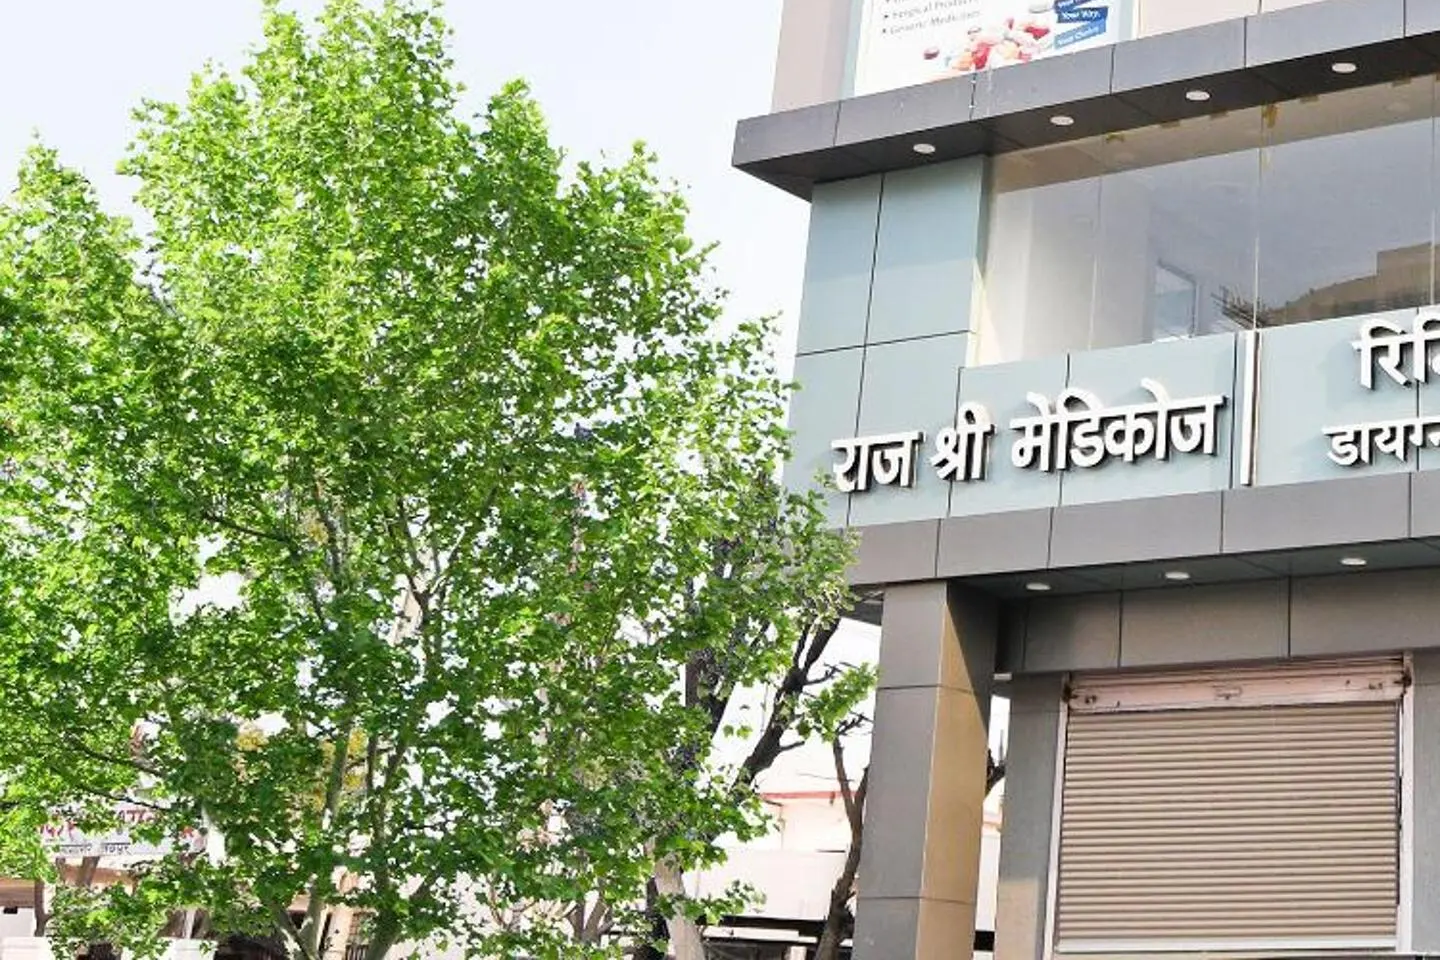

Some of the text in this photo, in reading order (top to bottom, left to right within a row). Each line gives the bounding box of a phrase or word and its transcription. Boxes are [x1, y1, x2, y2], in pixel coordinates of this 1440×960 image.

[831, 377, 1230, 493] राज श्री मेडिकोज
